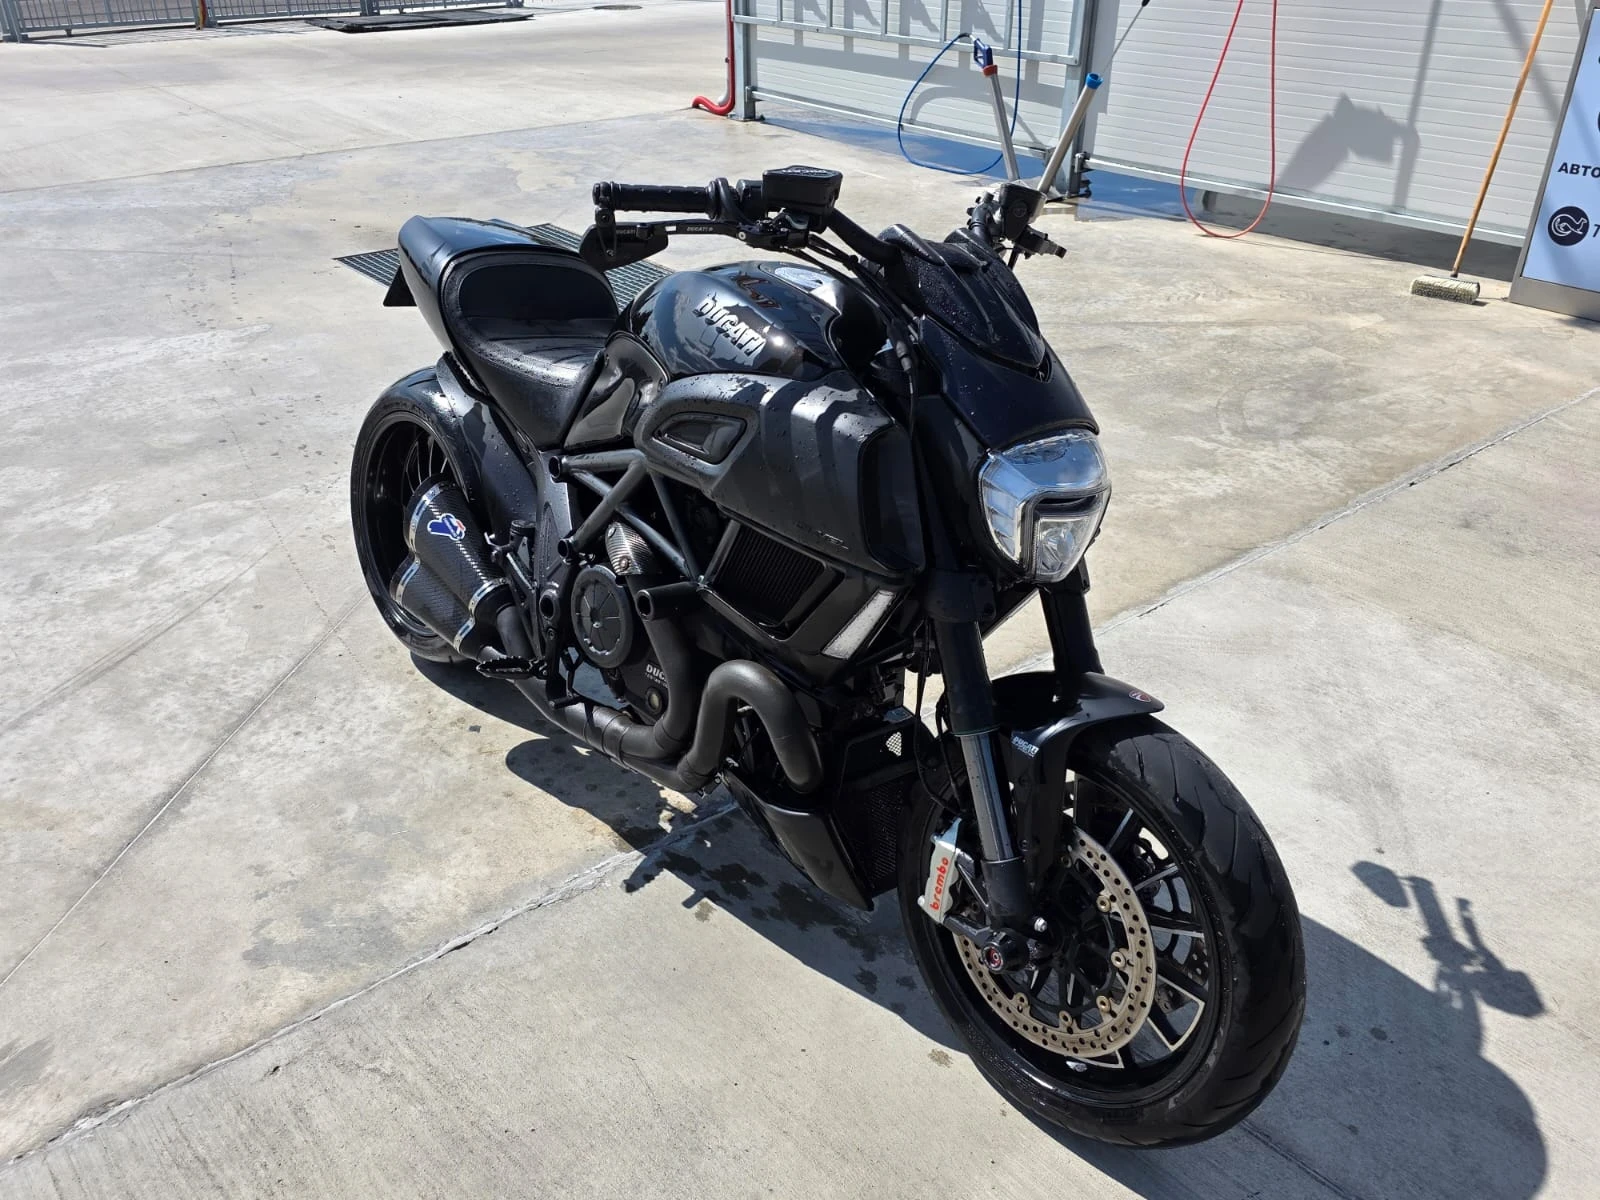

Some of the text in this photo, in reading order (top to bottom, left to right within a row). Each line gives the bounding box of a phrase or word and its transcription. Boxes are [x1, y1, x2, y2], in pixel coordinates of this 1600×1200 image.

[692, 297, 767, 357] DUCATI
[646, 664, 666, 681] DUC
[930, 857, 949, 911] brembo
